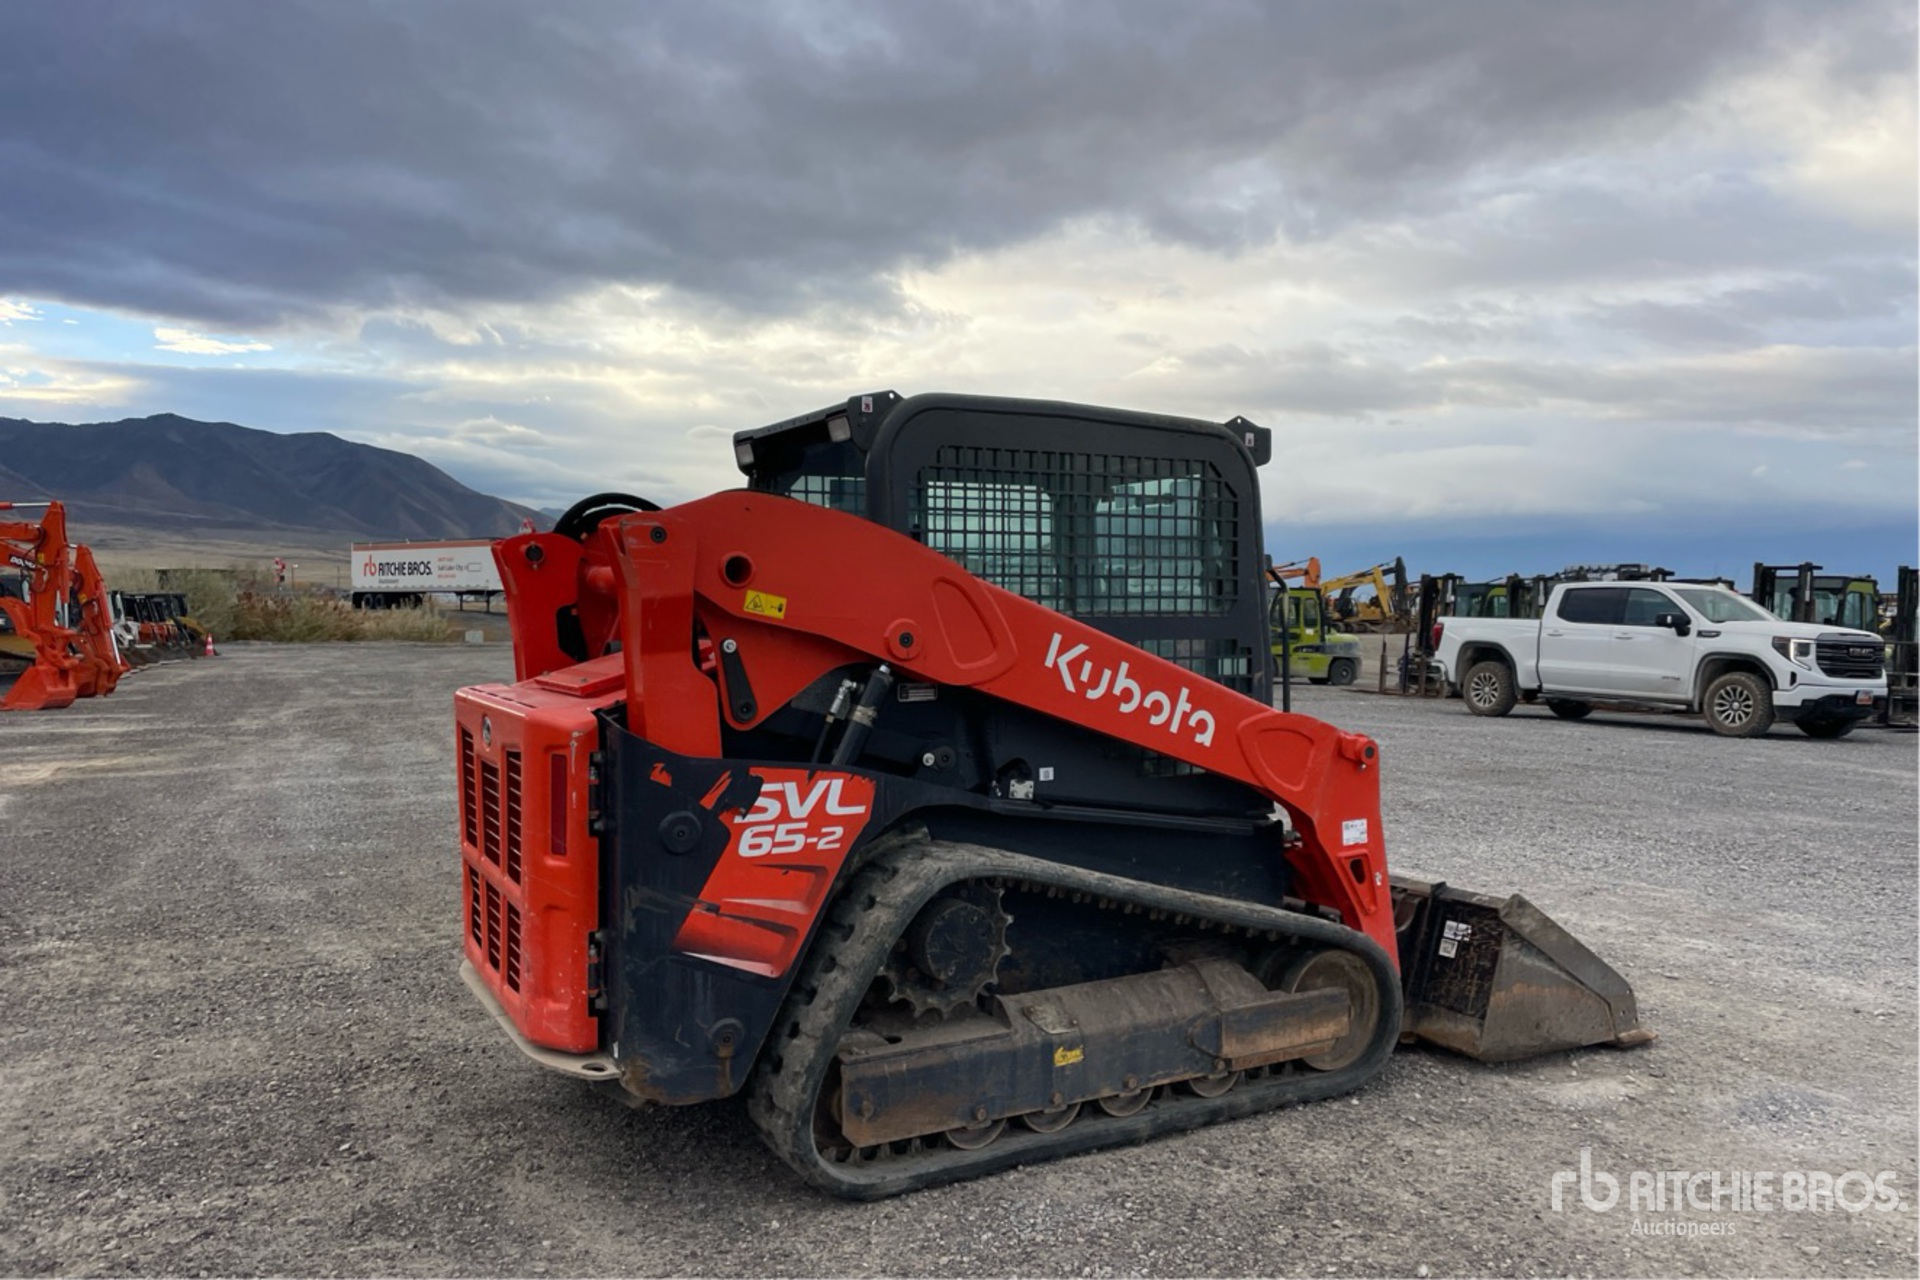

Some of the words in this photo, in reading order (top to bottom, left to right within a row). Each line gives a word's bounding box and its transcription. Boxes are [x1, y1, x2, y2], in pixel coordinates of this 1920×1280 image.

[363, 554, 377, 576] rb
[379, 562, 406, 576] RITCHIE
[407, 561, 433, 575] BROS.
[1044, 632, 1216, 748] Kubota
[733, 779, 867, 823] SVL
[738, 822, 844, 857] 65-2
